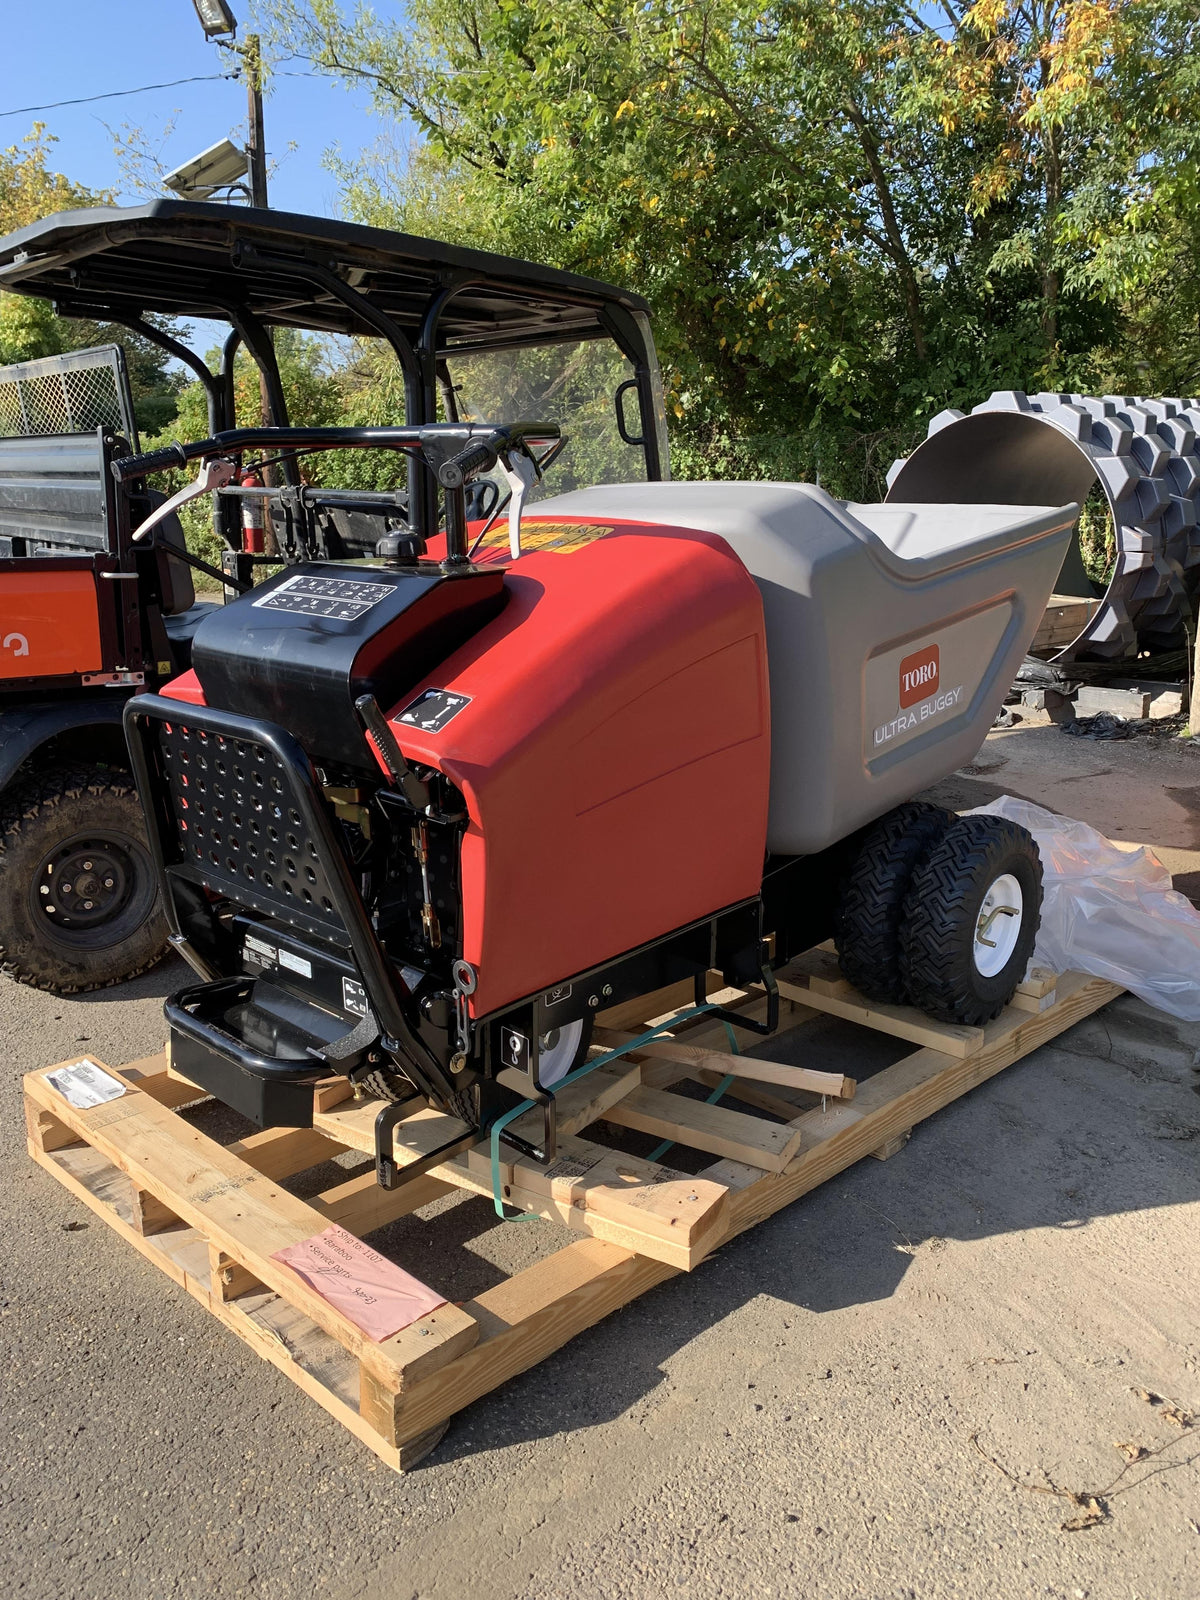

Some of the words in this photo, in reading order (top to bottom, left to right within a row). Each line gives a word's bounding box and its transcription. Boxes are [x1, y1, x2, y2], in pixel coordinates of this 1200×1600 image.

[902, 660, 937, 693] TORO
[874, 712, 917, 744] ULTRA
[920, 687, 961, 721] BUGGY
[311, 1246, 335, 1266] Service
[333, 1263, 352, 1279] parts
[325, 1239, 352, 1262] Baraboo
[337, 1231, 353, 1245] Ship
[353, 1241, 362, 1251] to:
[363, 1249, 384, 1264] 1107
